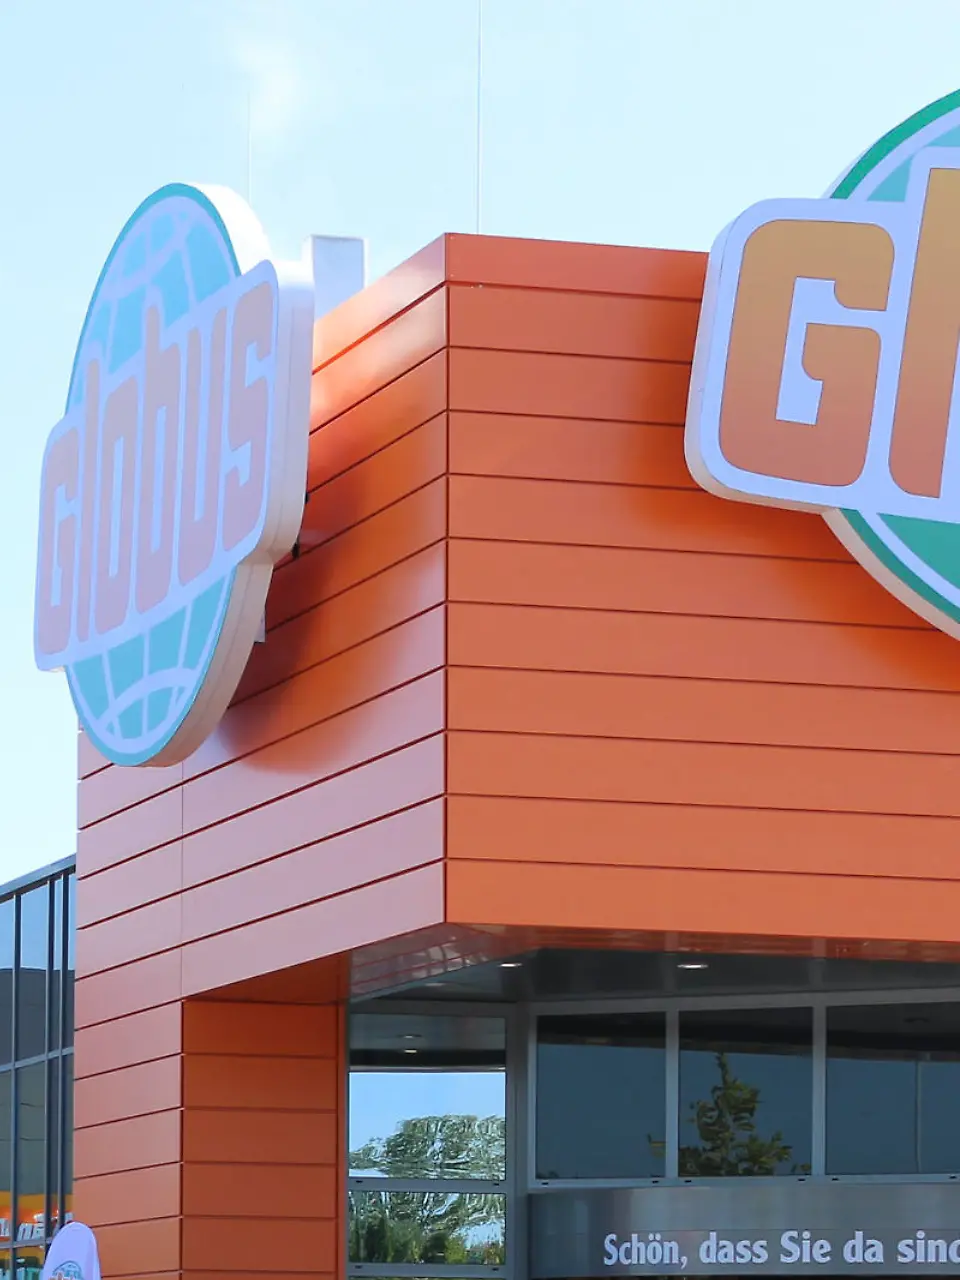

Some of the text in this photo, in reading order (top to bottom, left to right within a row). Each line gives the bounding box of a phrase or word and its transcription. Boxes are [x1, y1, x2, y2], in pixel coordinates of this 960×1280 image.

[603, 1232, 688, 1269] Schön,
[699, 1231, 768, 1264] dass
[780, 1230, 831, 1263] Sie
[843, 1231, 884, 1263] da
